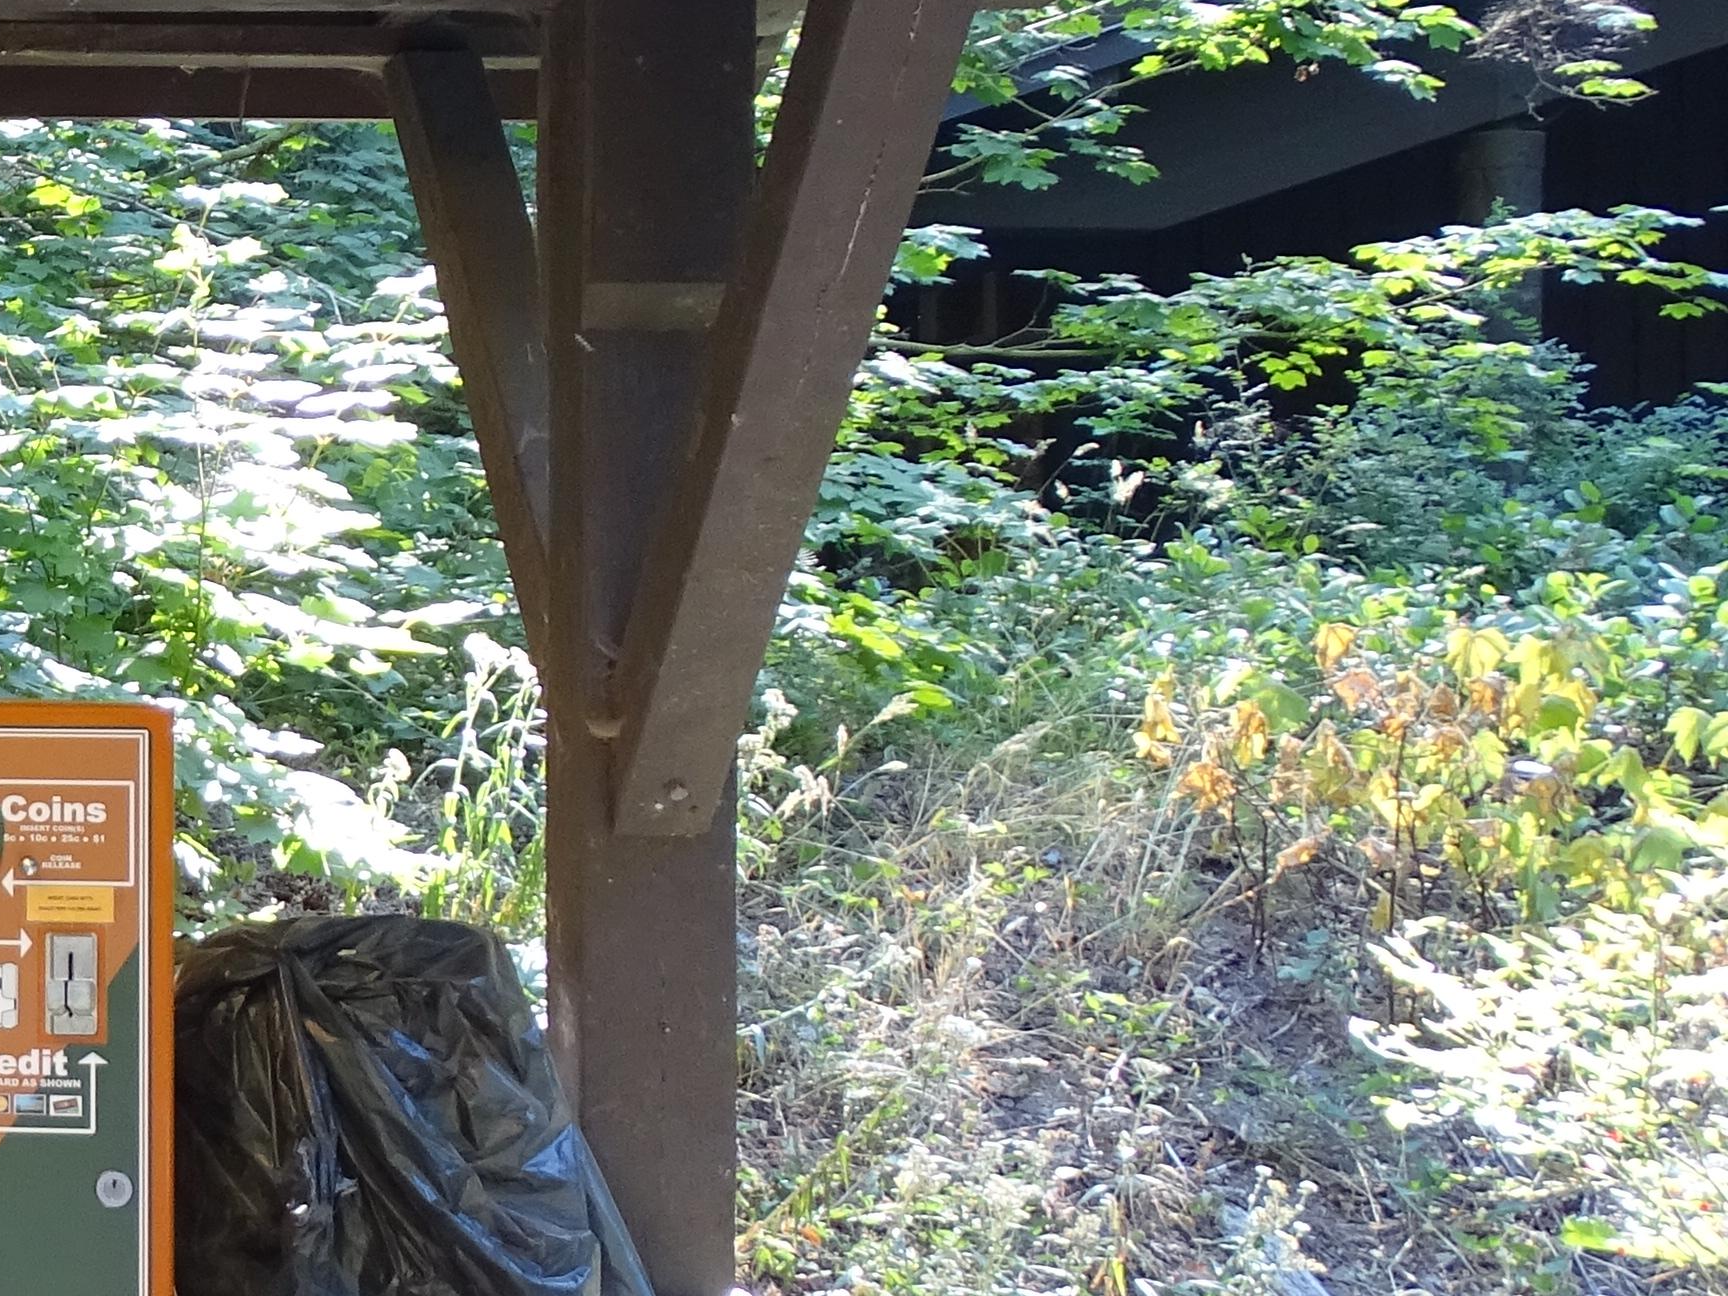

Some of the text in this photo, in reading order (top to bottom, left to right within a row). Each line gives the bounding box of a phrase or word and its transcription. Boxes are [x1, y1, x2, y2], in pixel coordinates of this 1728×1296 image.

[2, 795, 107, 823] Coins
[22, 1078, 37, 1087] AS
[40, 1079, 81, 1088] SHOWN
